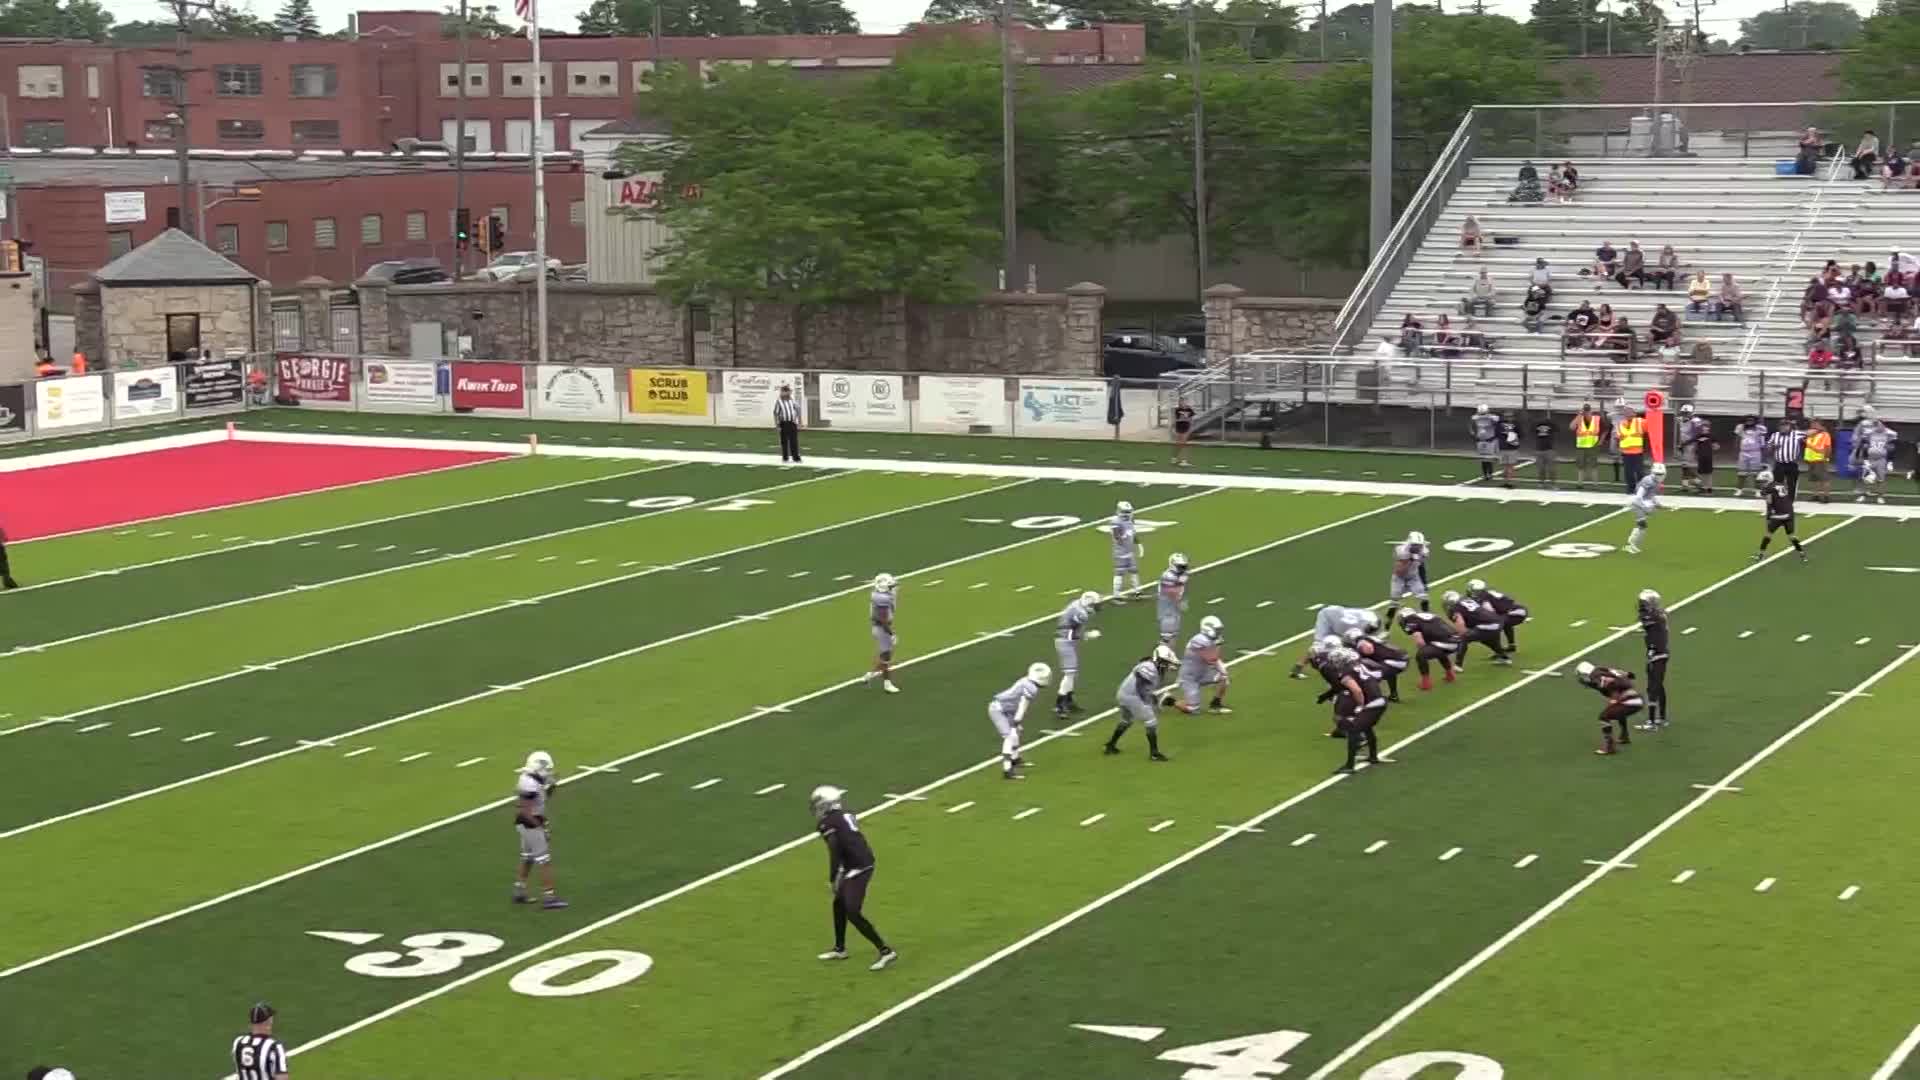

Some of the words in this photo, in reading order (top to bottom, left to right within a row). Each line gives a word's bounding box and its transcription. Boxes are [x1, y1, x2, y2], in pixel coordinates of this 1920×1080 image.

[649, 377, 689, 389] SCRUB
[658, 390, 689, 401] CLUB
[1788, 391, 1802, 408] 2
[241, 1047, 255, 1067] 6
